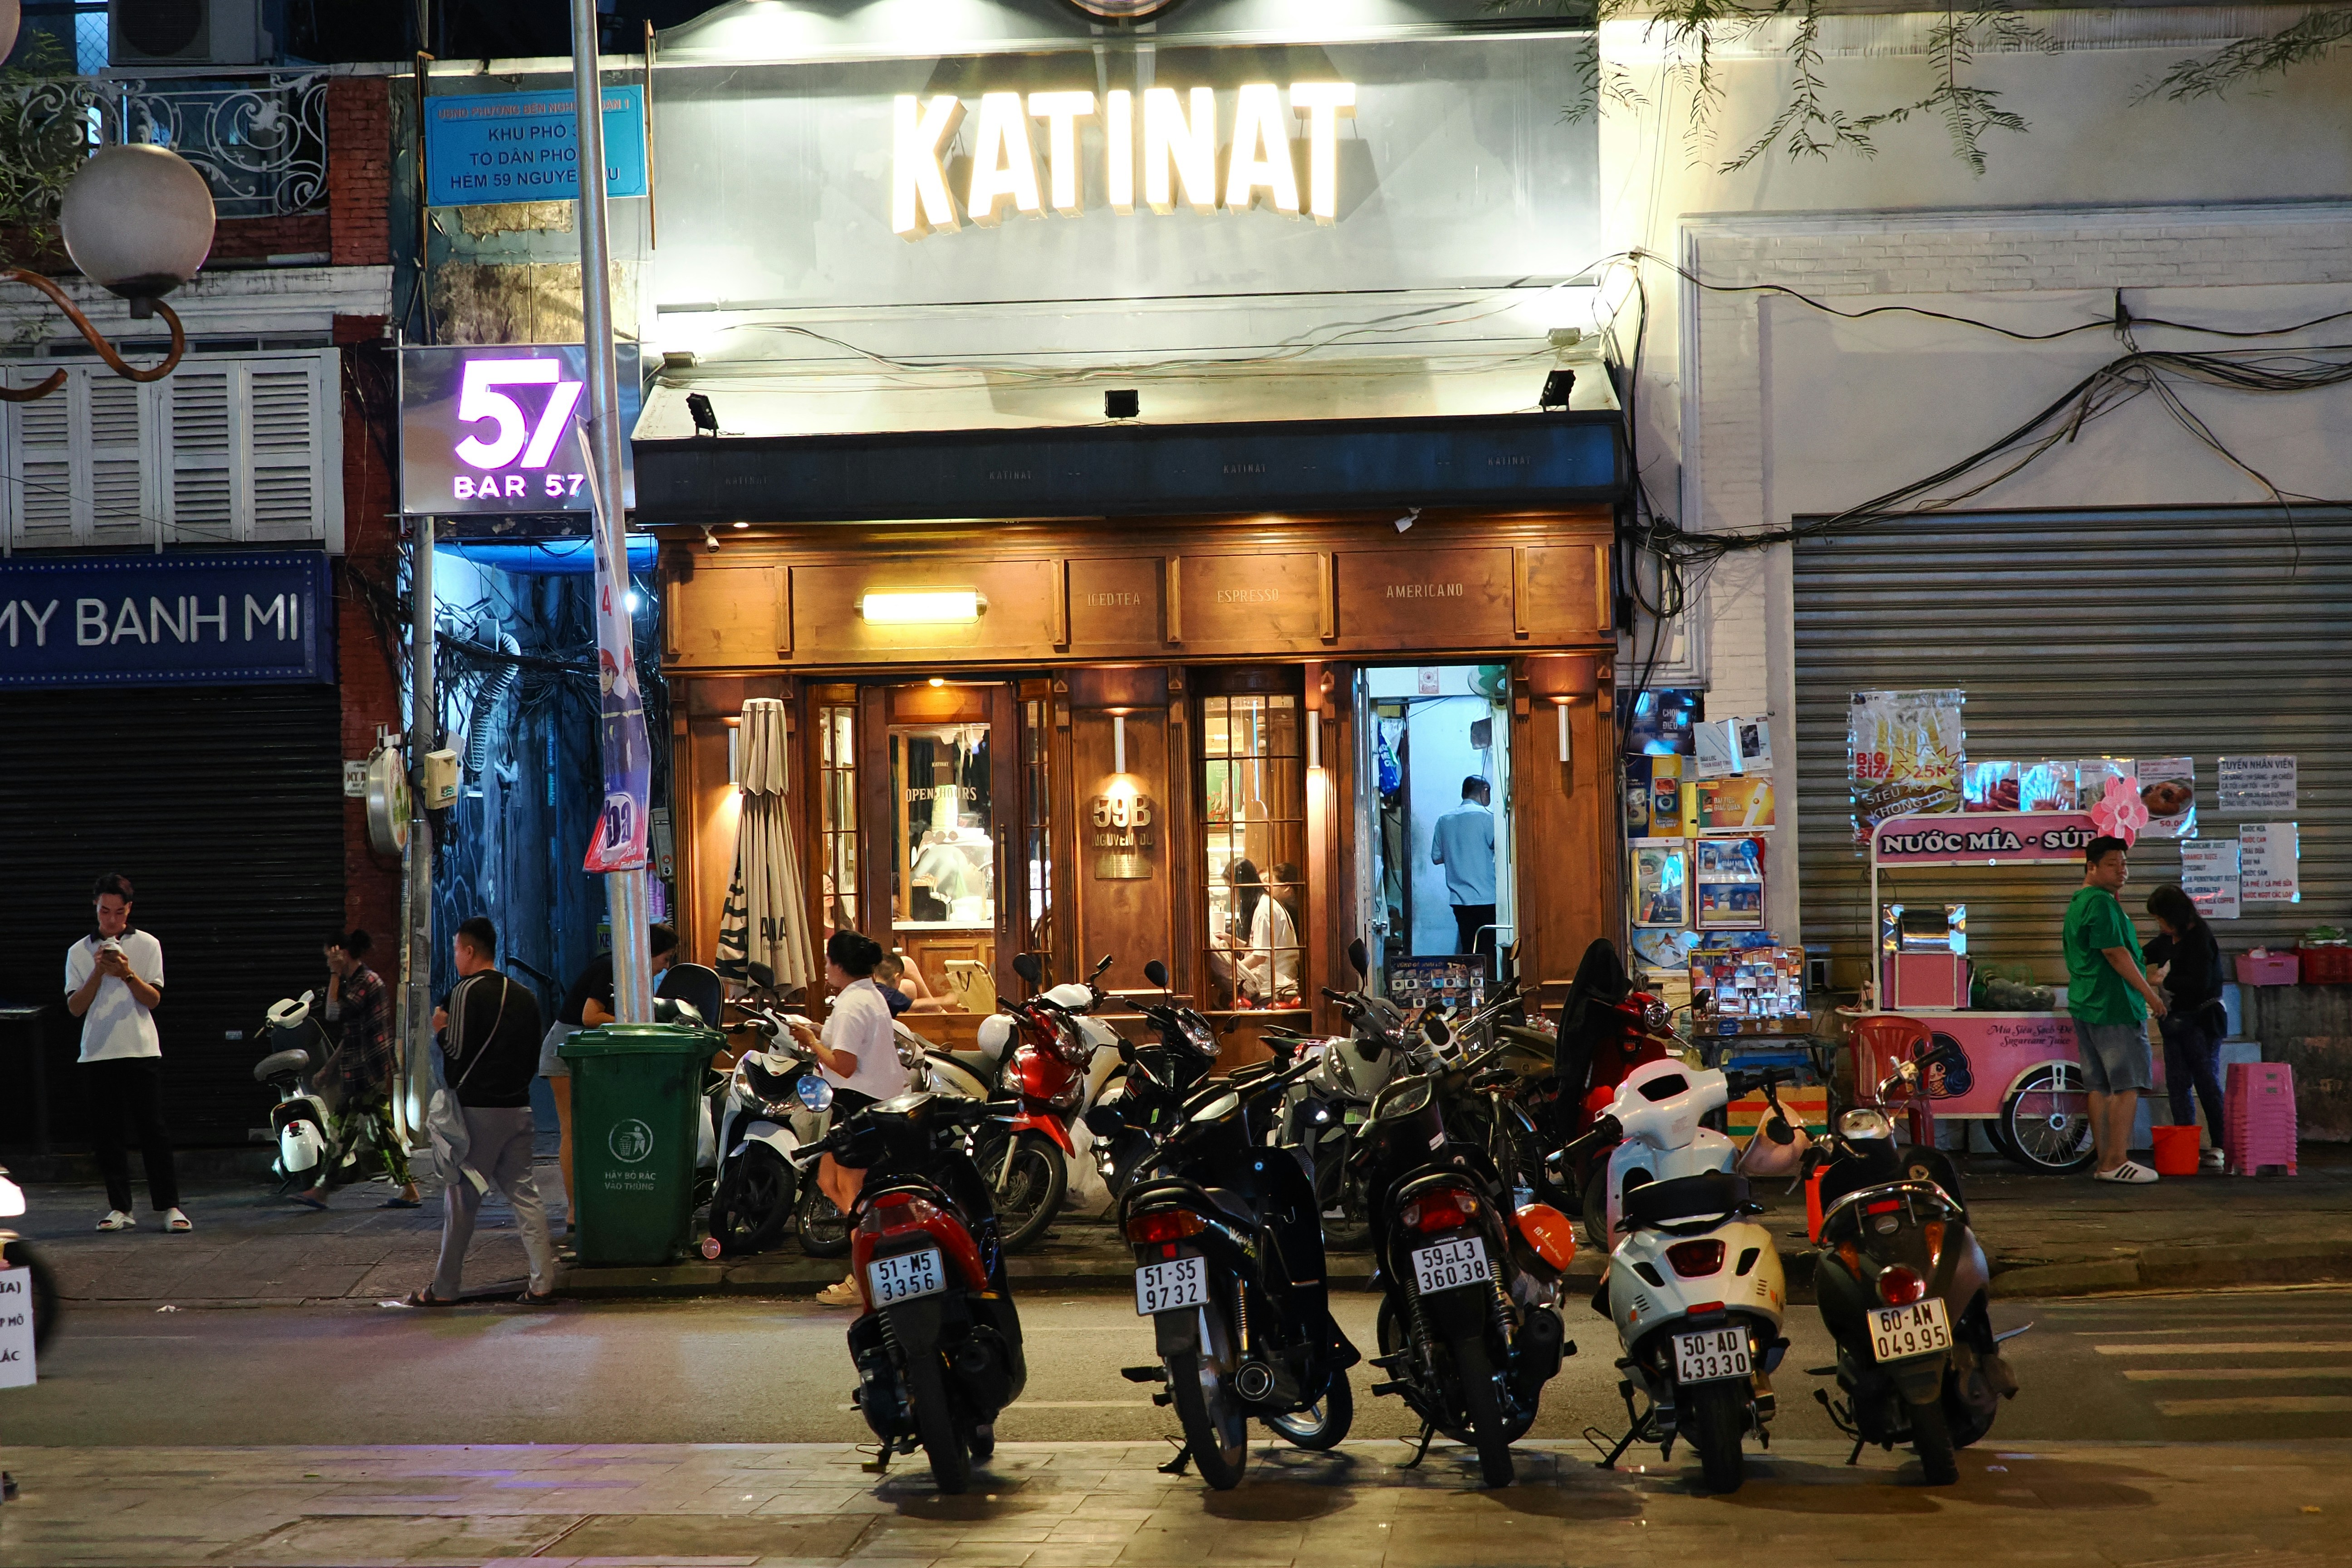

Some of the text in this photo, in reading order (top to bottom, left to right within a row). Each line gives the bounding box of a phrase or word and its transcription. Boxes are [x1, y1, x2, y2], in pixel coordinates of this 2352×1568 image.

[625, 98, 629, 109] 1
[489, 127, 524, 142] KHU
[500, 147, 534, 165] DÂN
[892, 82, 1358, 240] KATINAT
[493, 173, 511, 186] 59
[455, 358, 584, 470] 57
[1224, 464, 1266, 473] KATINAT
[1488, 455, 1531, 466] KATINAT
[726, 475, 767, 486] KATINAT
[990, 470, 1032, 480] KATINAT
[454, 474, 584, 499] BAR 57
[1217, 588, 1279, 603] ESPRESSO
[1386, 583, 1463, 598] AMERICANO
[76, 594, 228, 647] BANH
[244, 592, 299, 642] MI
[1856, 752, 1886, 765] BIG
[1856, 764, 1948, 779] SIZE 25K
[905, 787, 977, 803] OPEN HOURS
[1093, 794, 1151, 828] 59B
[1882, 829, 1963, 853] NƯỚC
[1968, 827, 2023, 851] MÍA
[1986, 1024, 2011, 1035] Mía
[2000, 1035, 2071, 1047] Sugarcane Juice
[605, 1170, 622, 1179] HÃY
[604, 1180, 654, 1191] VÀO THÙNG
[1229, 1226, 1254, 1249] Wave
[1421, 1241, 1475, 1268] 59-L3
[878, 1253, 931, 1280] 51-M5
[1145, 1260, 1196, 1288] 51-S5
[1421, 1260, 1485, 1290] 360.38
[882, 1273, 935, 1301] 3356
[1146, 1282, 1198, 1310] 9732
[1880, 1303, 1933, 1333] 60-AN
[1683, 1331, 1738, 1357] 50-AD
[1877, 1325, 1945, 1357] 049.95
[1683, 1352, 1746, 1380] 433.30
